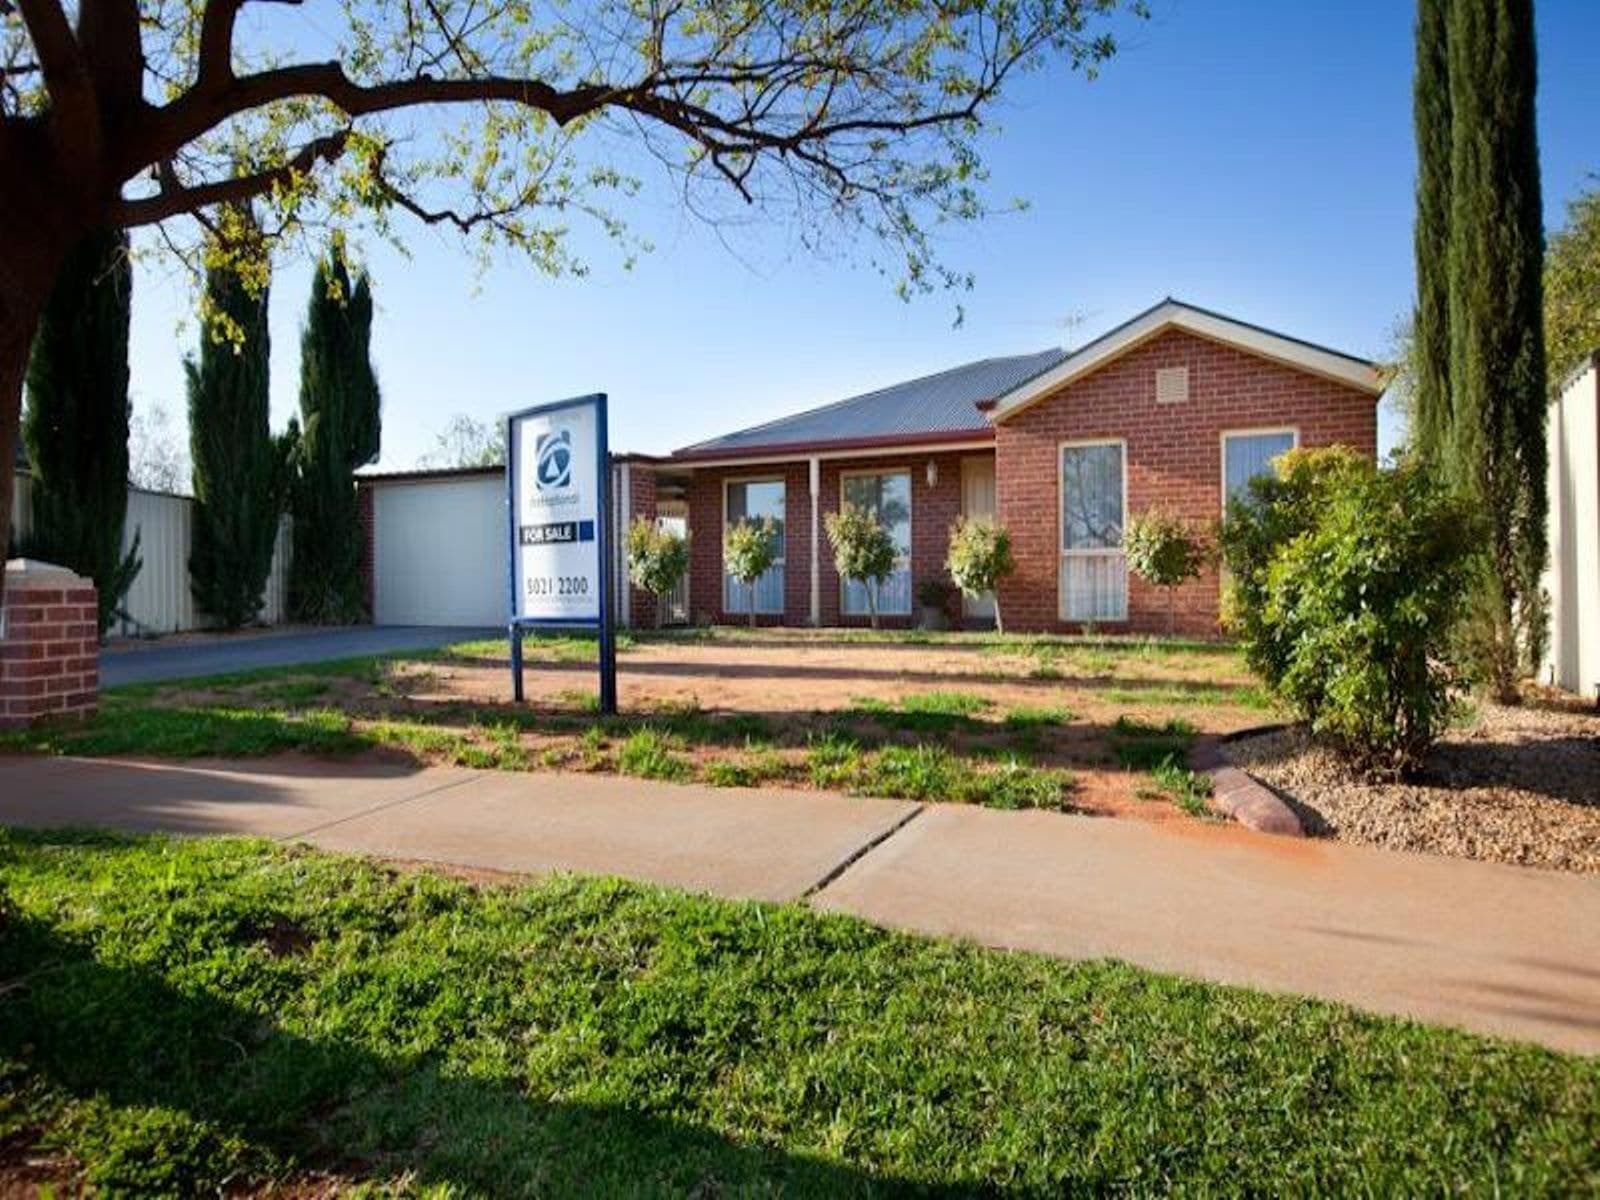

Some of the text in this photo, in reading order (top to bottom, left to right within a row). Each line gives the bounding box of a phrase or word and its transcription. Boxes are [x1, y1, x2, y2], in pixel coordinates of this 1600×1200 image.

[524, 526, 572, 543] FOR SALE
[527, 575, 589, 595] 5021 2200
